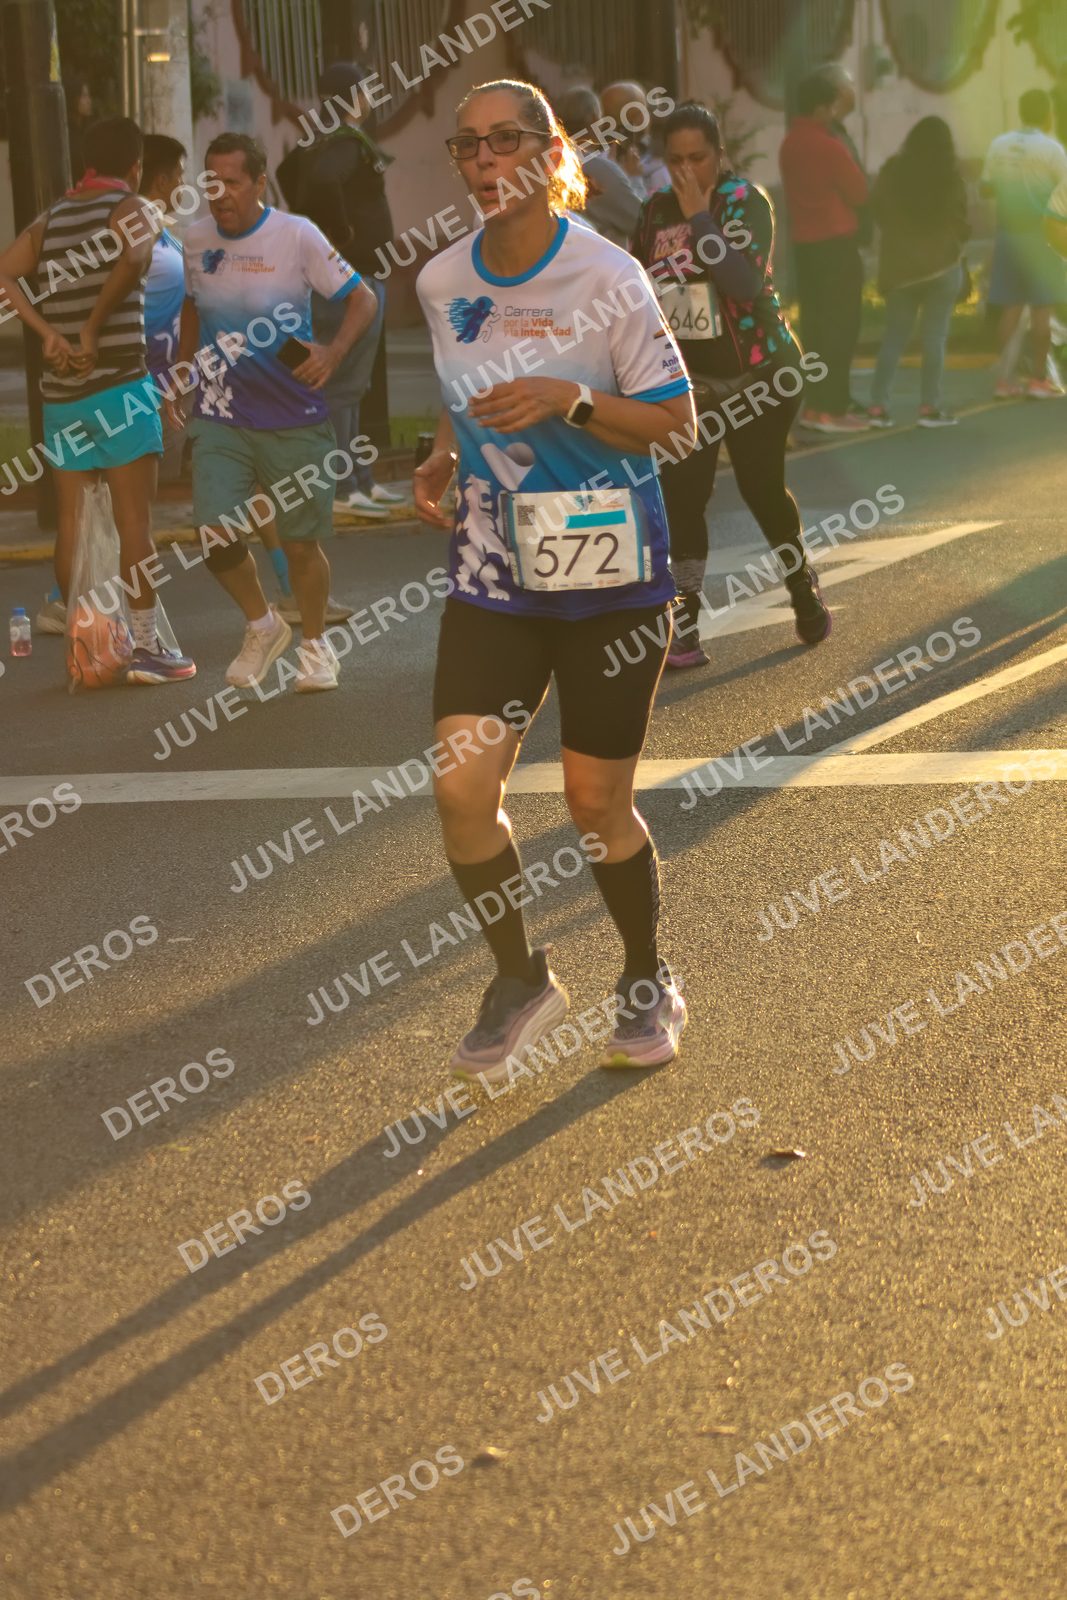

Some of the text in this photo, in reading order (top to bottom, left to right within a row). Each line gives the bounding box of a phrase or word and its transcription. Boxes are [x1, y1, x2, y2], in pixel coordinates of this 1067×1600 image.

[504, 305, 554, 317] Carrera
[669, 307, 709, 331] 646
[503, 319, 519, 329] por
[531, 317, 554, 327] Vida
[533, 532, 620, 578] 572
